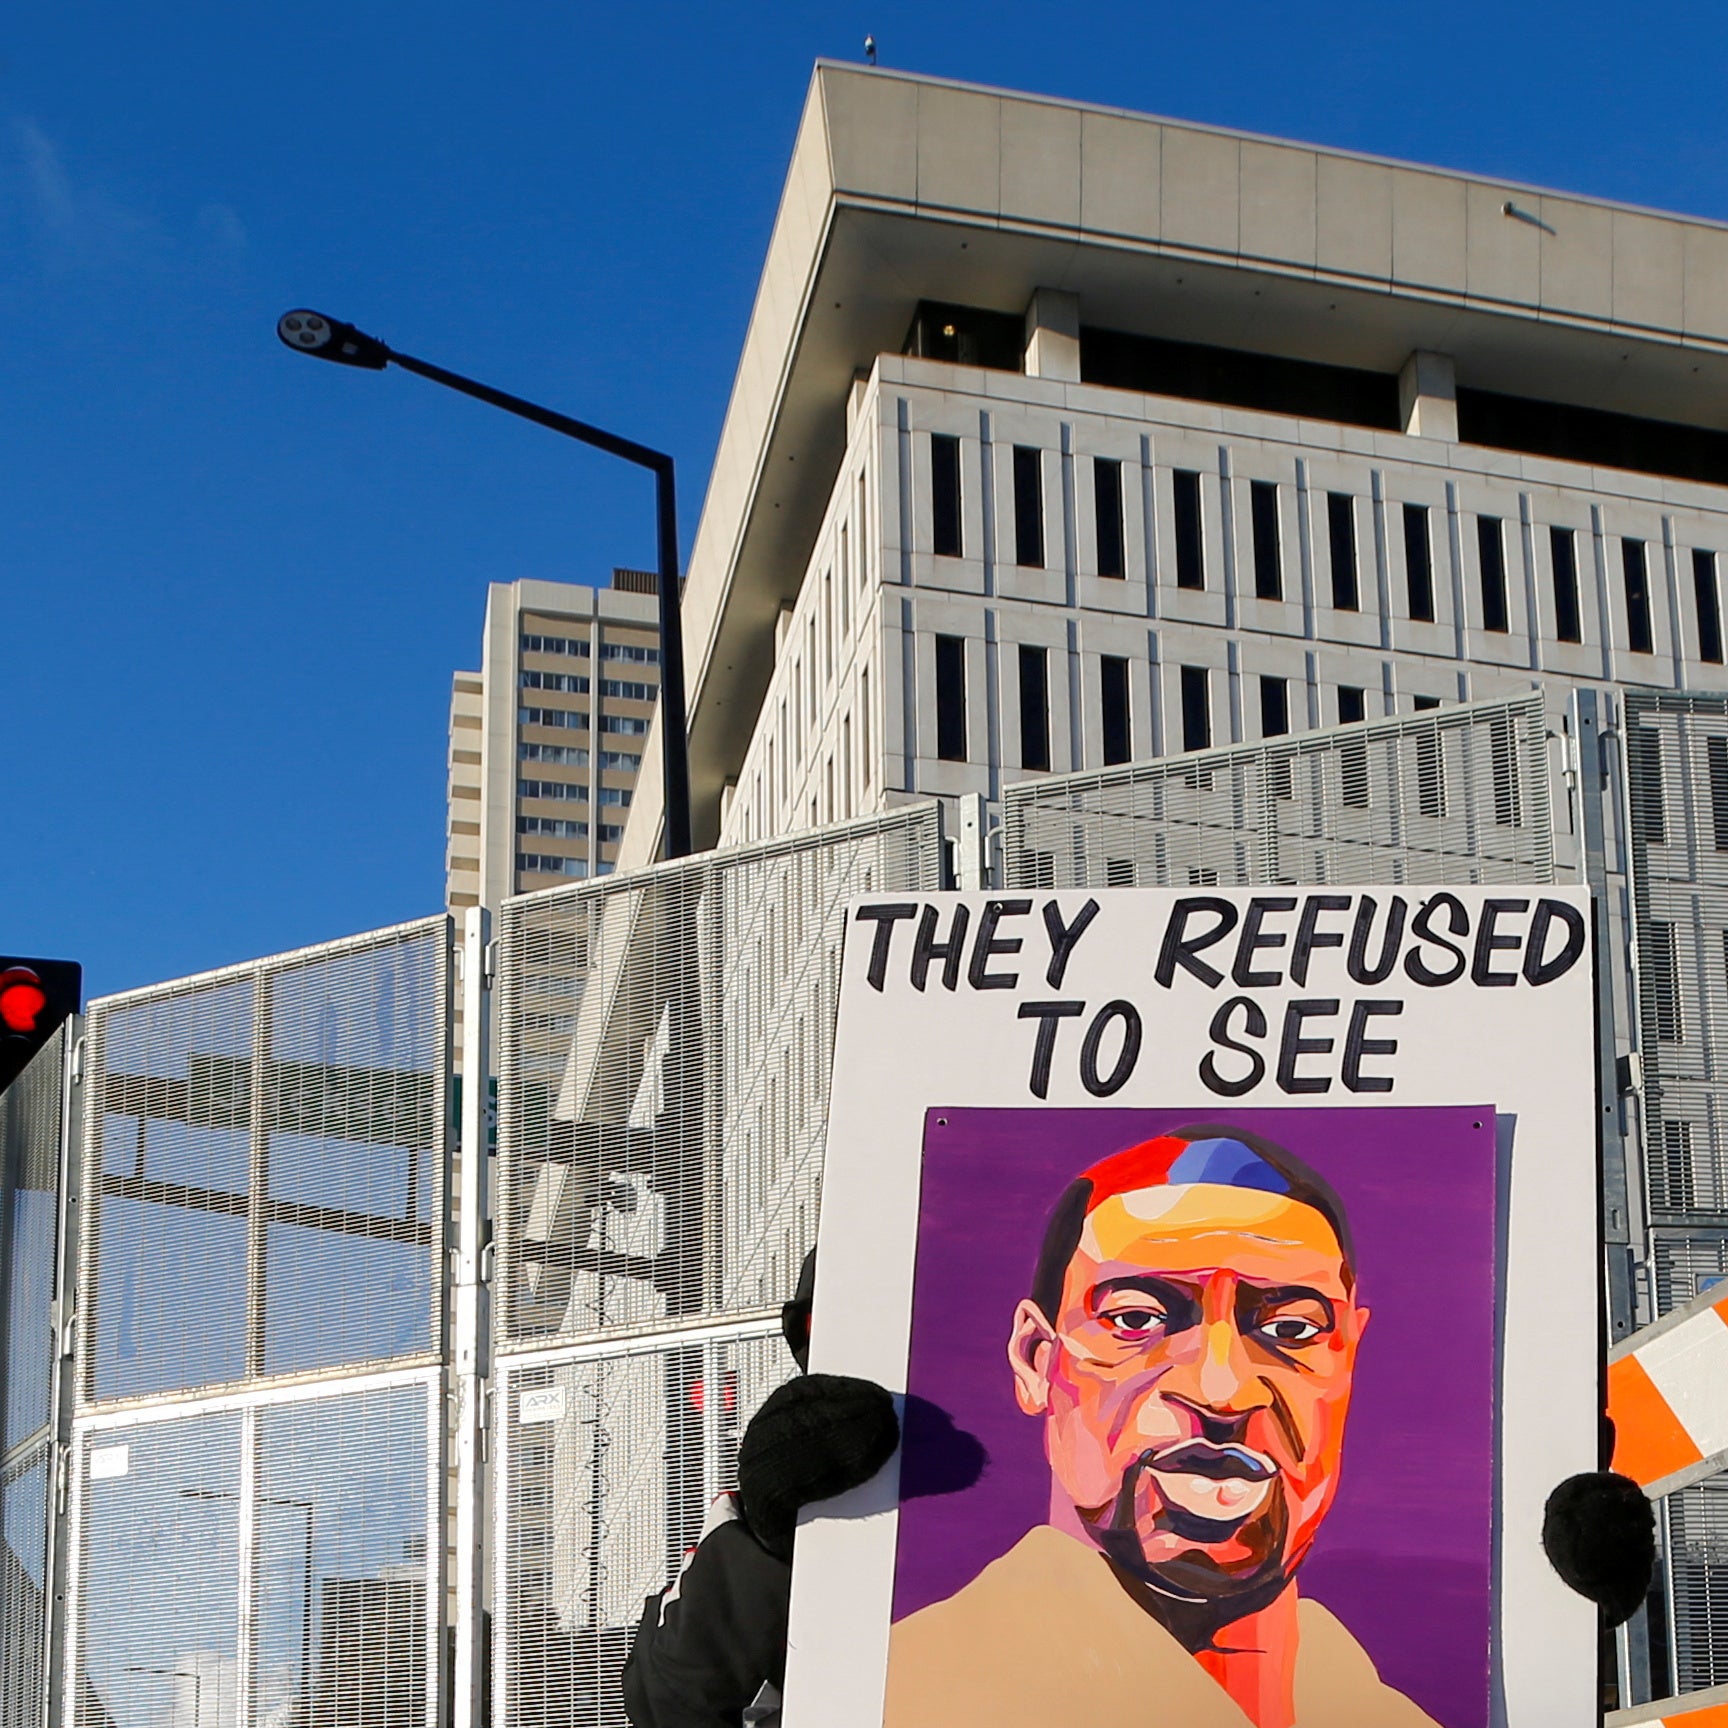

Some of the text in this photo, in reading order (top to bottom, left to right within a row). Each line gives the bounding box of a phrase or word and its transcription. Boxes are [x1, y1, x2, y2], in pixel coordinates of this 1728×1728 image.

[855, 891, 1587, 993] THEY REFUSED
[1017, 995, 1404, 1100] TO SEE
